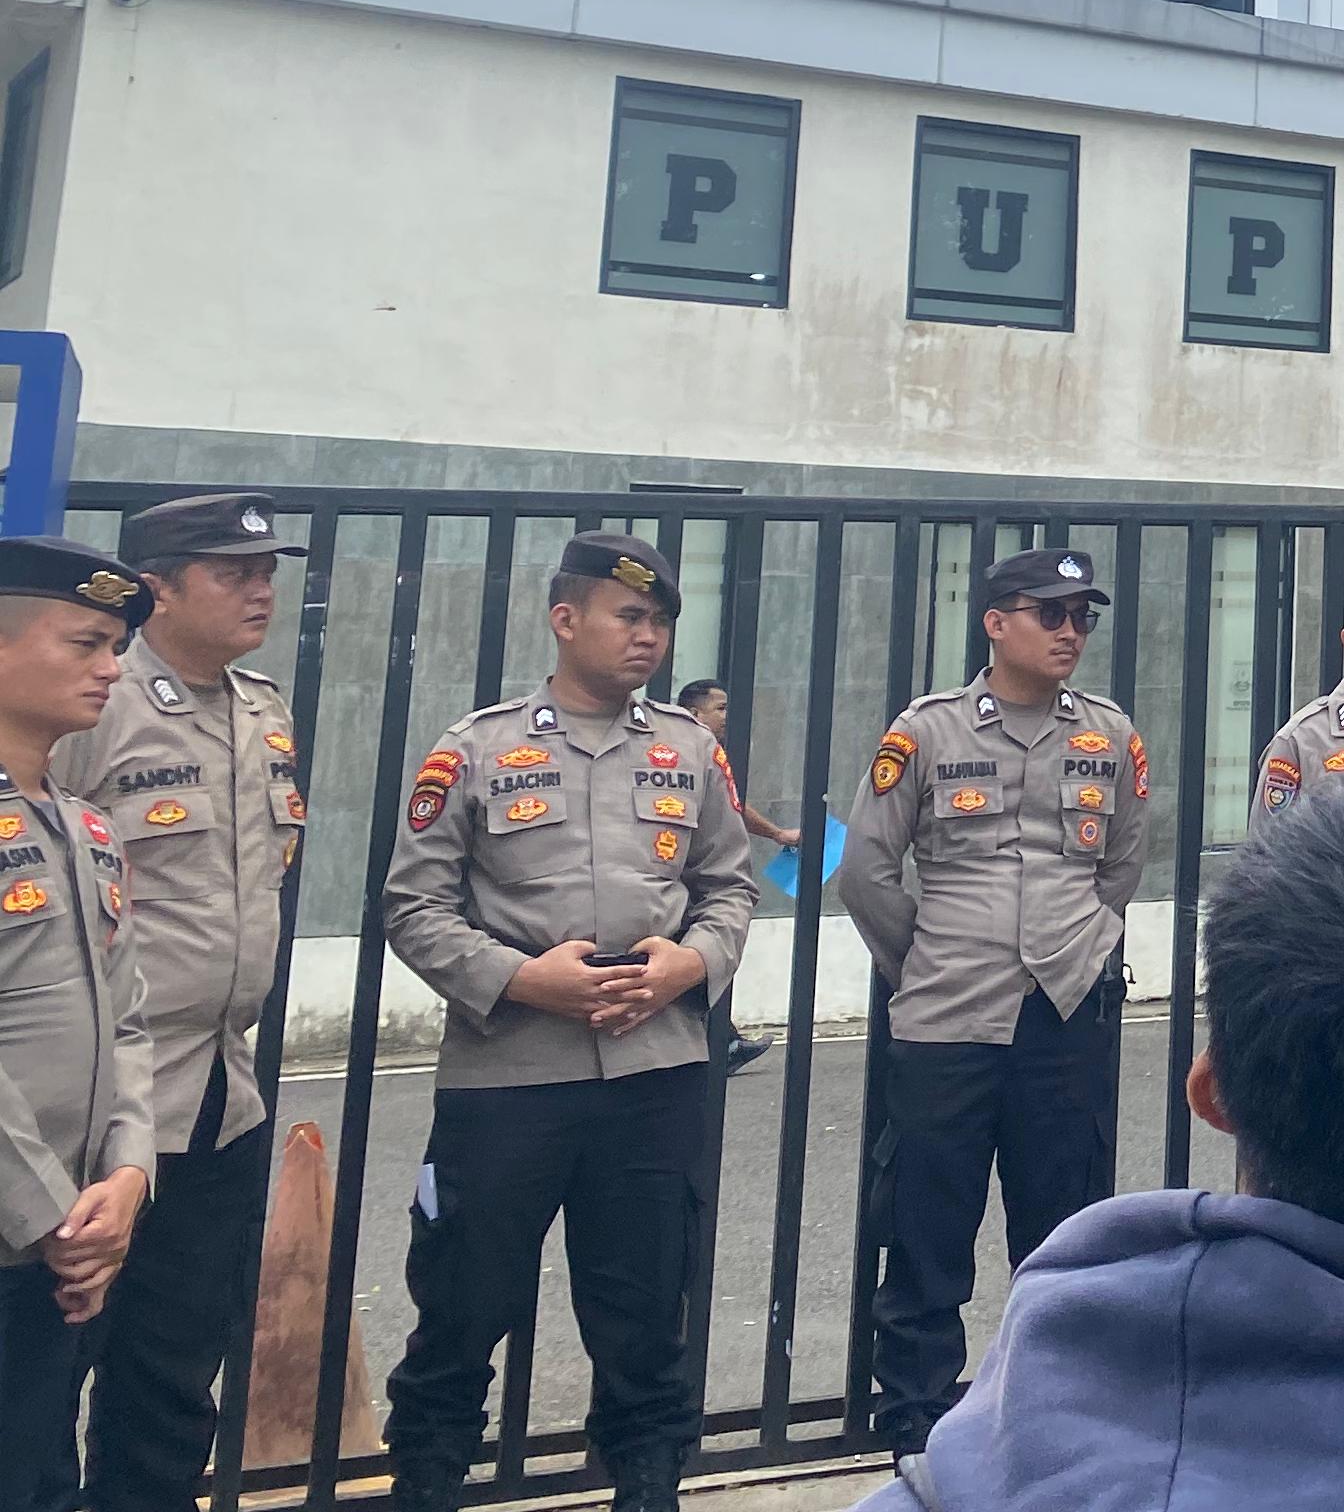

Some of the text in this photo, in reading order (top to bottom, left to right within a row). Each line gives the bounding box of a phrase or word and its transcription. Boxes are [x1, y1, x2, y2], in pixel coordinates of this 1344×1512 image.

[660, 154, 737, 245] P
[956, 186, 1029, 274] U
[1226, 216, 1286, 297] P
[634, 769, 695, 791] POLRI
[1064, 759, 1117, 779] POLRI
[490, 770, 561, 797] S.BACHRI
